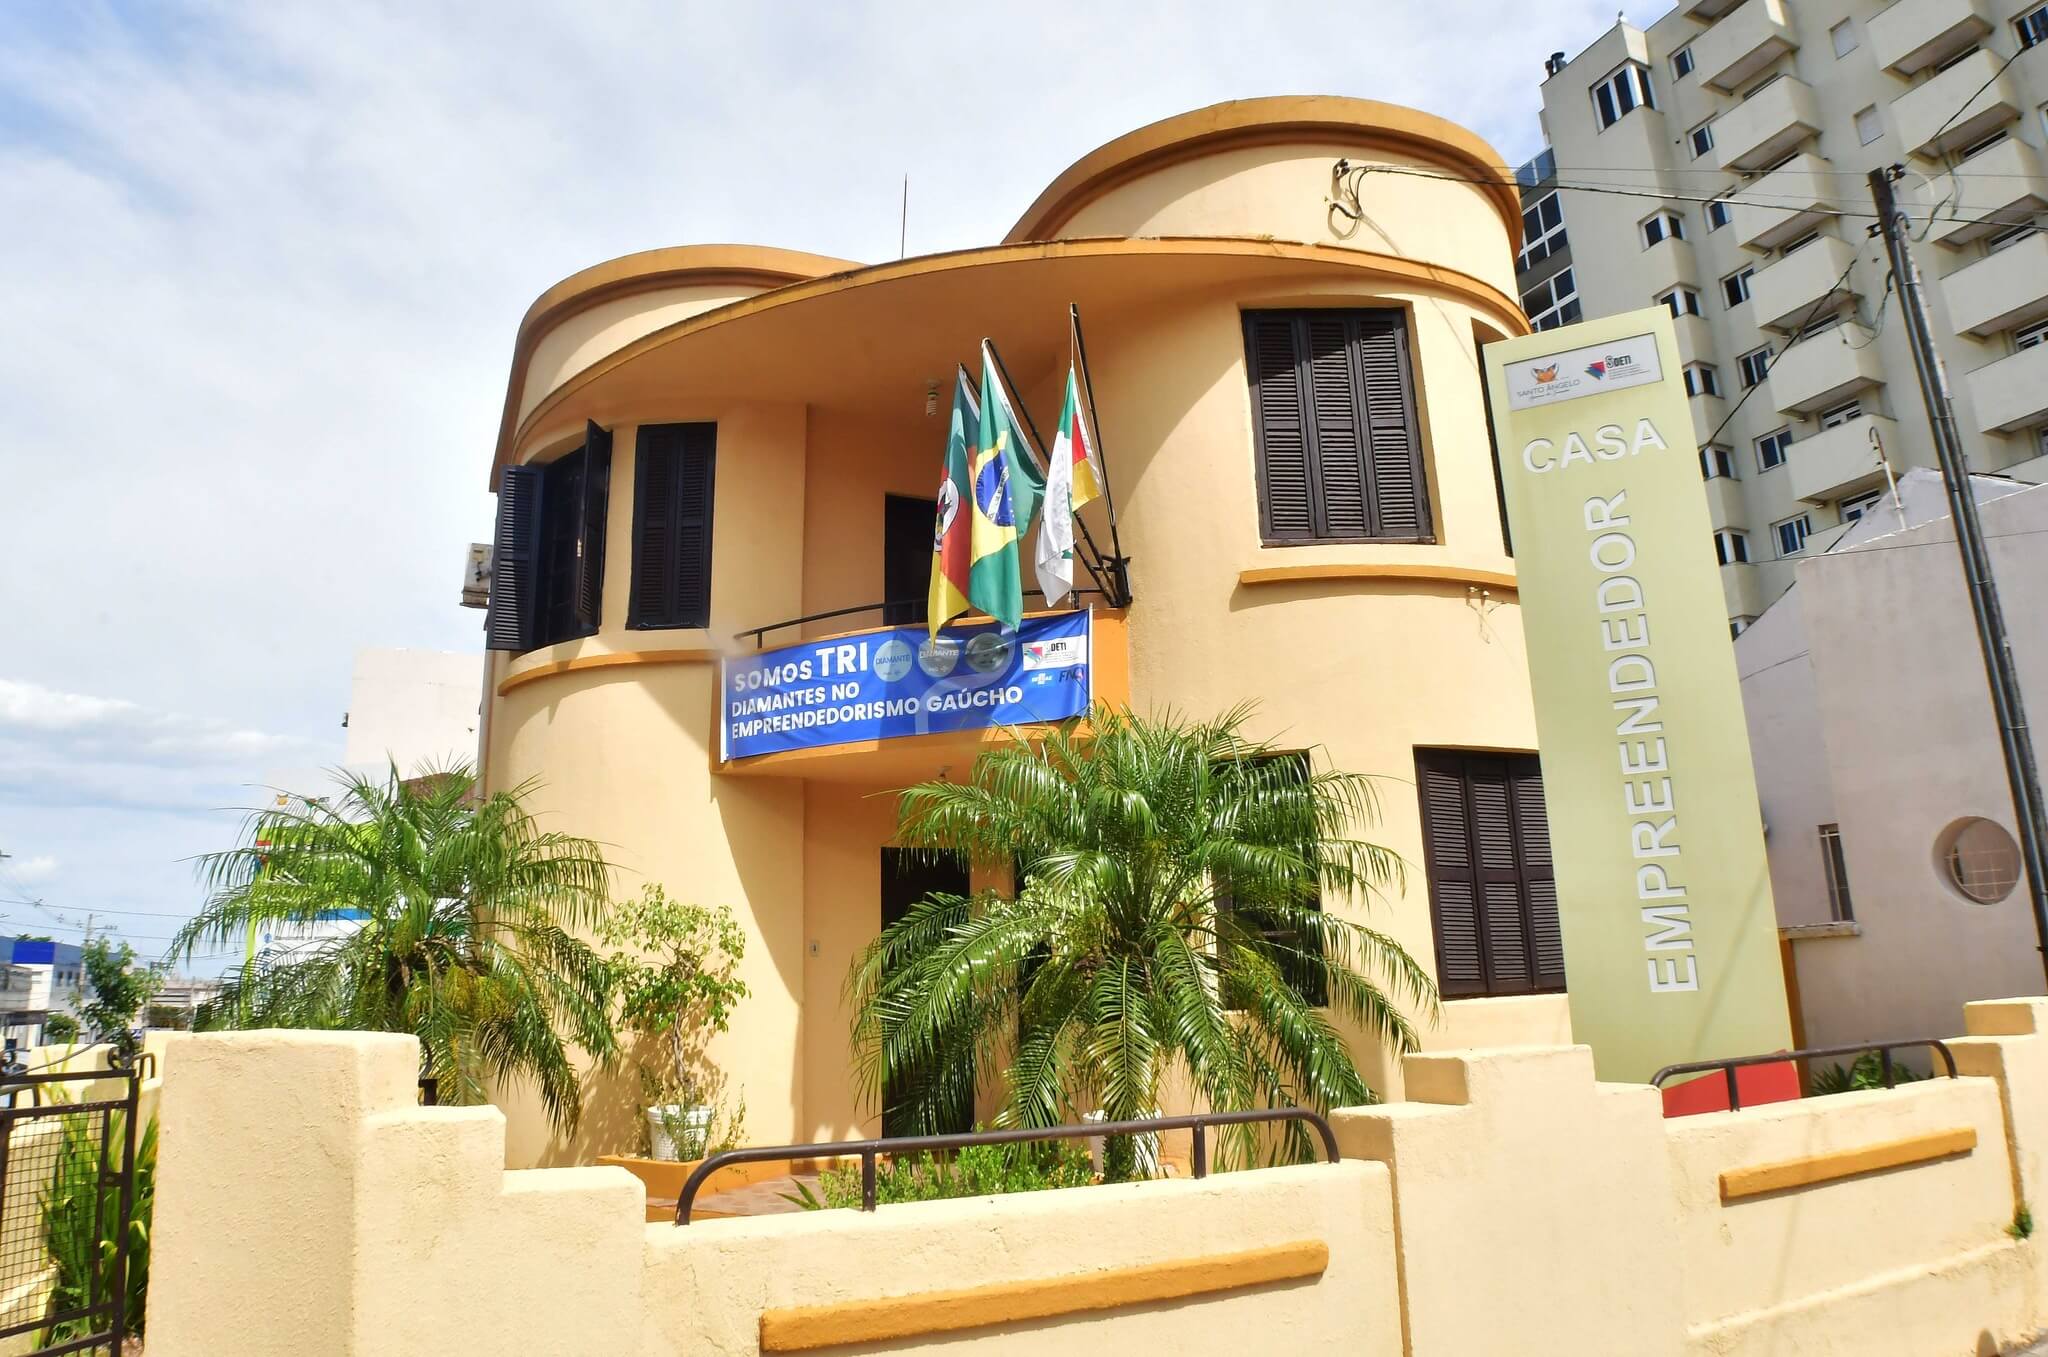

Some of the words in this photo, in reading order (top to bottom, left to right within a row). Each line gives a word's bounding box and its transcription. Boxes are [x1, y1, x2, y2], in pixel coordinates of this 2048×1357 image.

[1522, 418, 1669, 474] CASA
[735, 660, 813, 692] SOMOS
[816, 642, 868, 677] TRI
[876, 654, 912, 666] DIAMANTE
[732, 686, 826, 717] DIAMANTES
[832, 682, 860, 701] NO
[732, 697, 920, 739] EMPREENDEDORISMO
[926, 687, 1023, 712] GAÚCHO
[1584, 489, 1699, 992] EMPREENDEDOR
